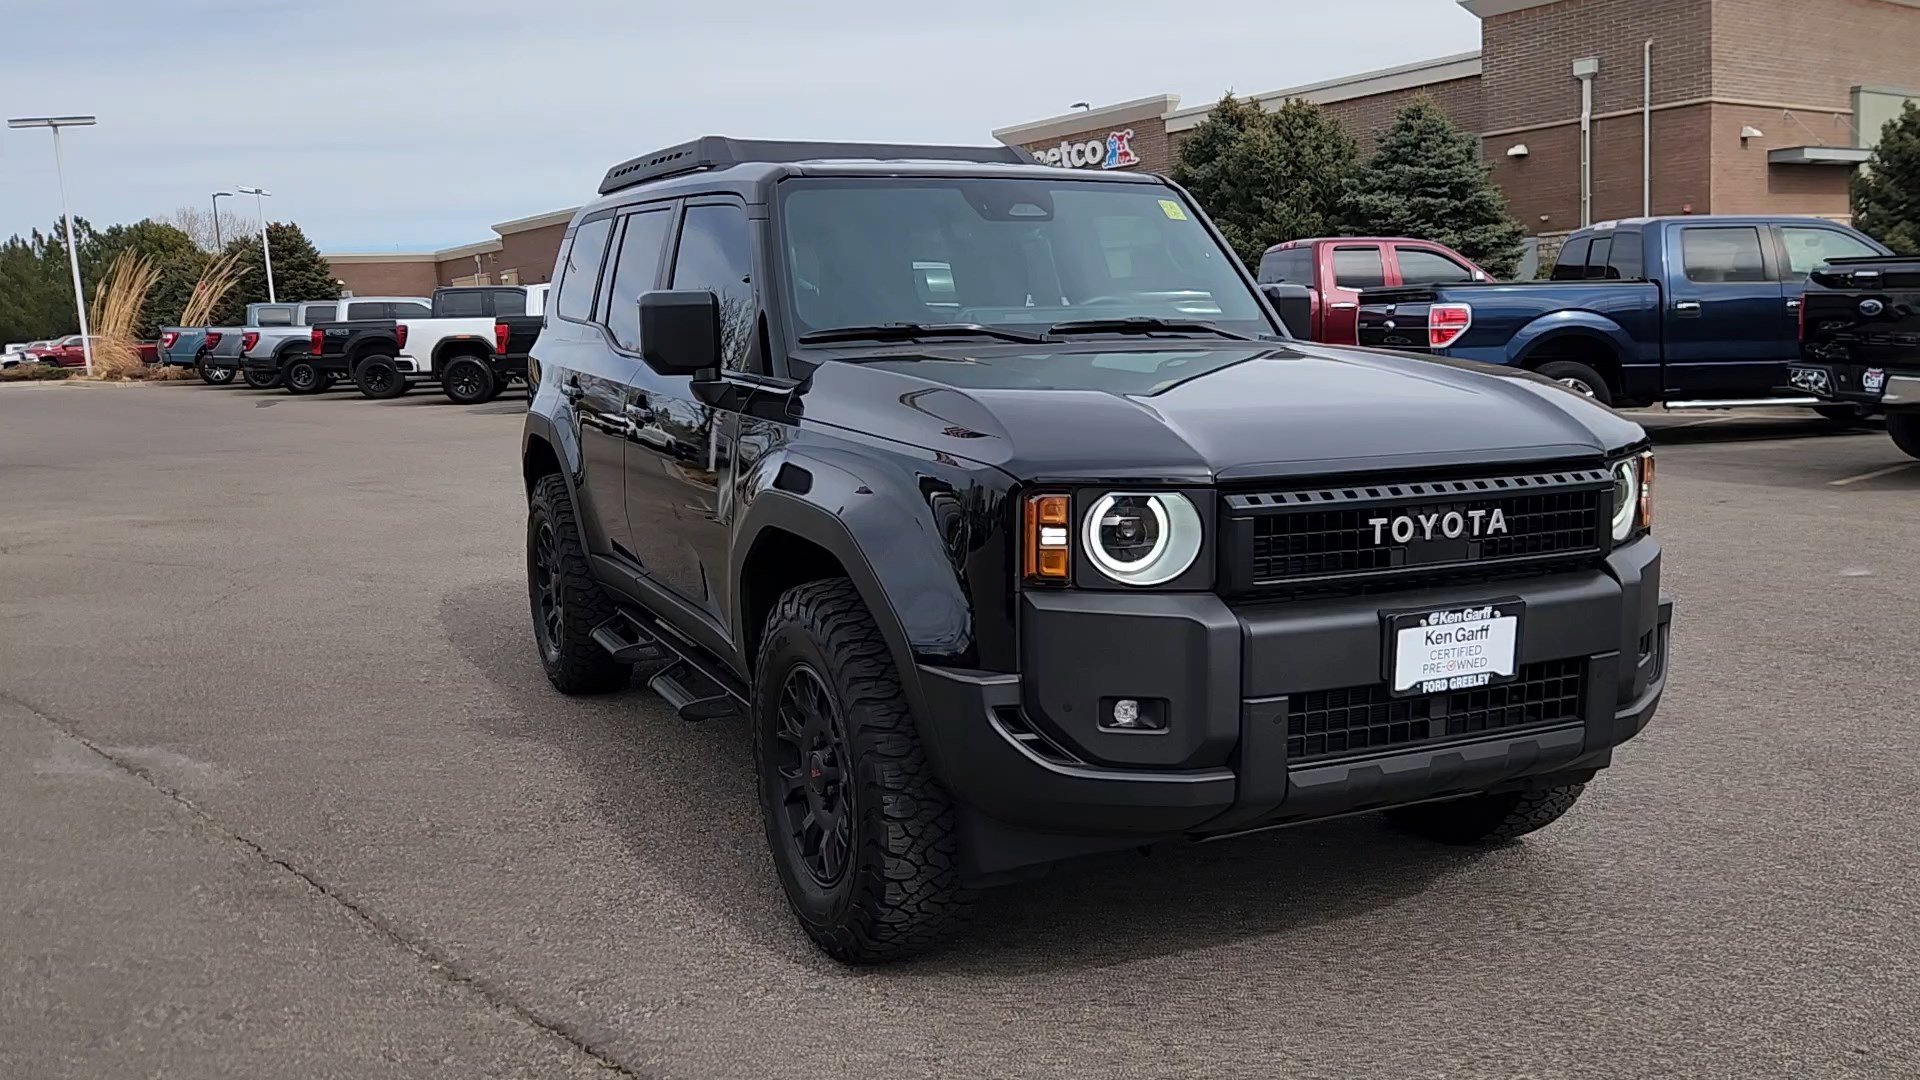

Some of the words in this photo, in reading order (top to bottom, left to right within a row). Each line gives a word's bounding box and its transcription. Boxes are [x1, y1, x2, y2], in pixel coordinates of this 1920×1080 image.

[1369, 508, 1508, 545] TOYOTA
[1439, 611, 1463, 624] Ken
[1463, 607, 1492, 622] Garff
[1425, 630, 1452, 646] Ken
[1455, 624, 1491, 642] Garff
[1430, 645, 1482, 661] CERTIFIED
[1423, 678, 1448, 694] FORD
[1449, 674, 1490, 690] GREELEY
